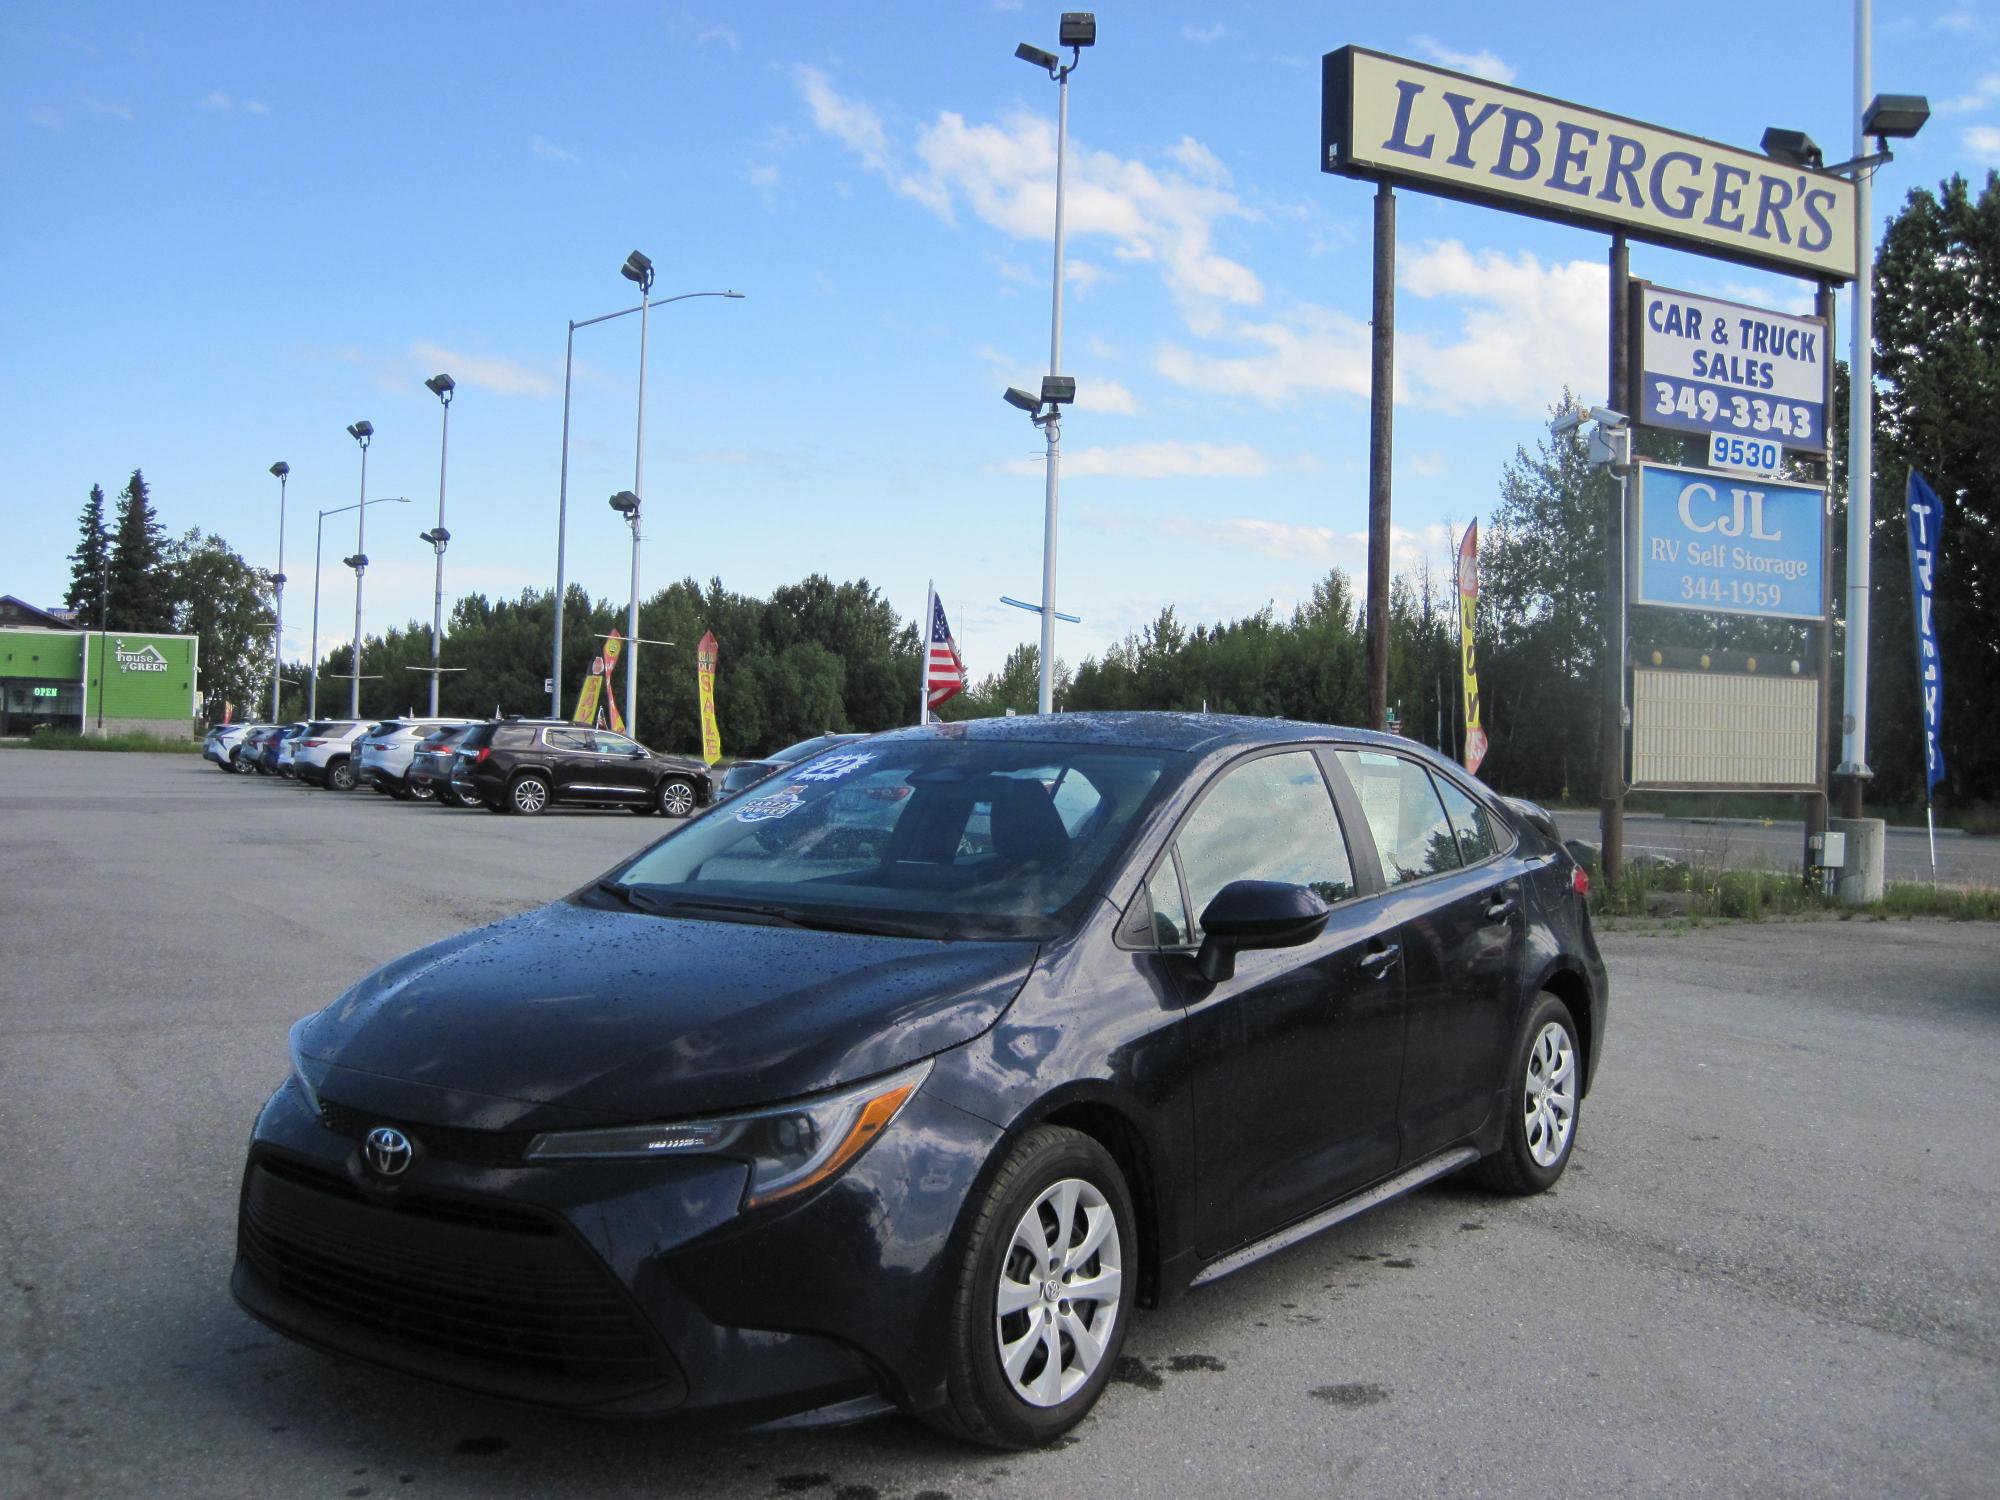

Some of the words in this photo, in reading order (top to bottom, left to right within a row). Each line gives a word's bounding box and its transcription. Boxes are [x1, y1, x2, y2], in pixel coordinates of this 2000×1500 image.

[1382, 79, 1837, 252] LYBERGER'S
[1647, 300, 1703, 340] CAR
[1710, 317, 1729, 346] &
[1739, 318, 1817, 364] TRUCK
[1692, 349, 1775, 390] SALES
[1654, 381, 1812, 439] 349-3343
[1713, 436, 1777, 470] 9530
[1677, 482, 1782, 541] CJL
[1650, 537, 1681, 562] RV
[1687, 541, 1727, 569] Self
[1732, 547, 1809, 581] Storage
[1680, 575, 1782, 608] 344-1959
[116, 650, 154, 663] house
[120, 662, 129, 673] of
[129, 662, 168, 672] GREEN
[34, 687, 58, 697] OPEN
